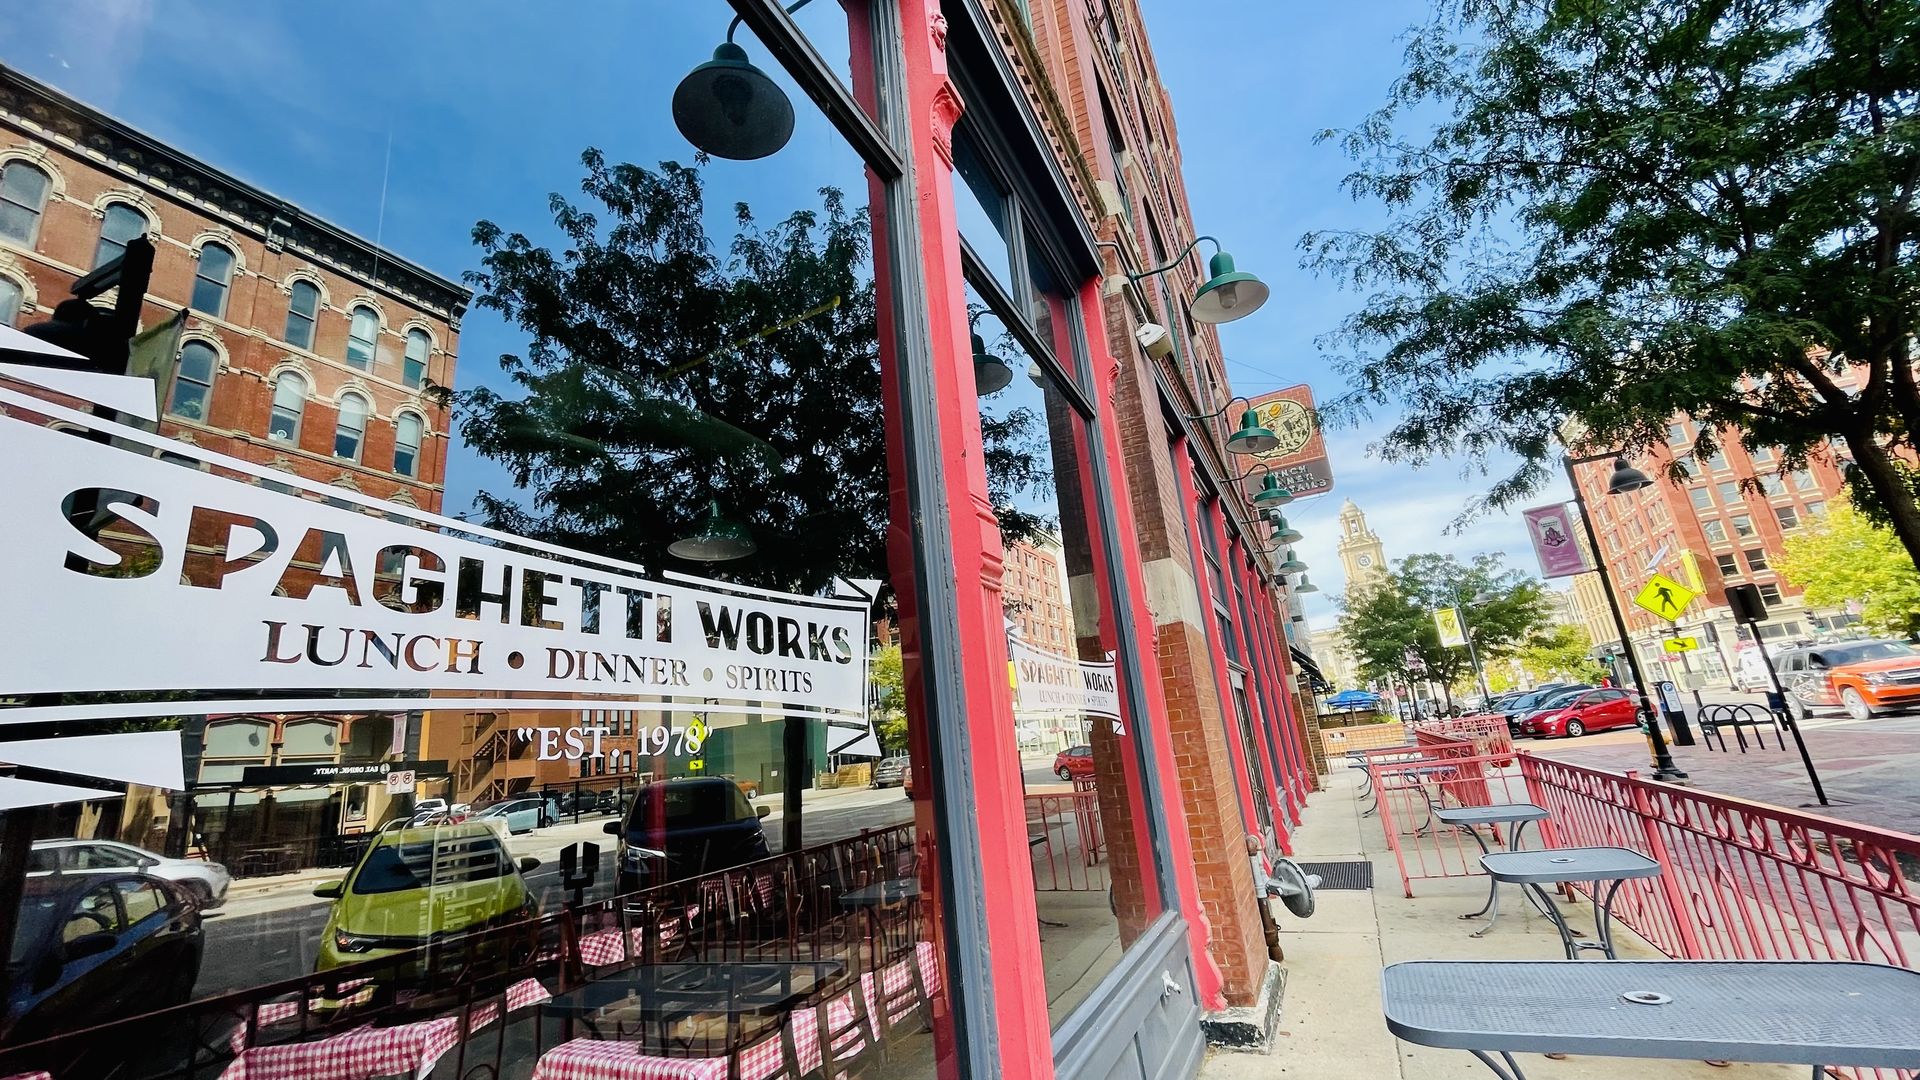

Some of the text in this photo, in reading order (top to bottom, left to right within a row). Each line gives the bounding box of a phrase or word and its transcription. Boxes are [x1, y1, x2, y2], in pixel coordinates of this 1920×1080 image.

[61, 487, 852, 665] SPAGHETTI WORKS
[260, 620, 812, 694] LUNCH DINNER SPIRITS
[1039, 690, 1061, 704] LUNCH
[1083, 671, 1114, 693] WORKS
